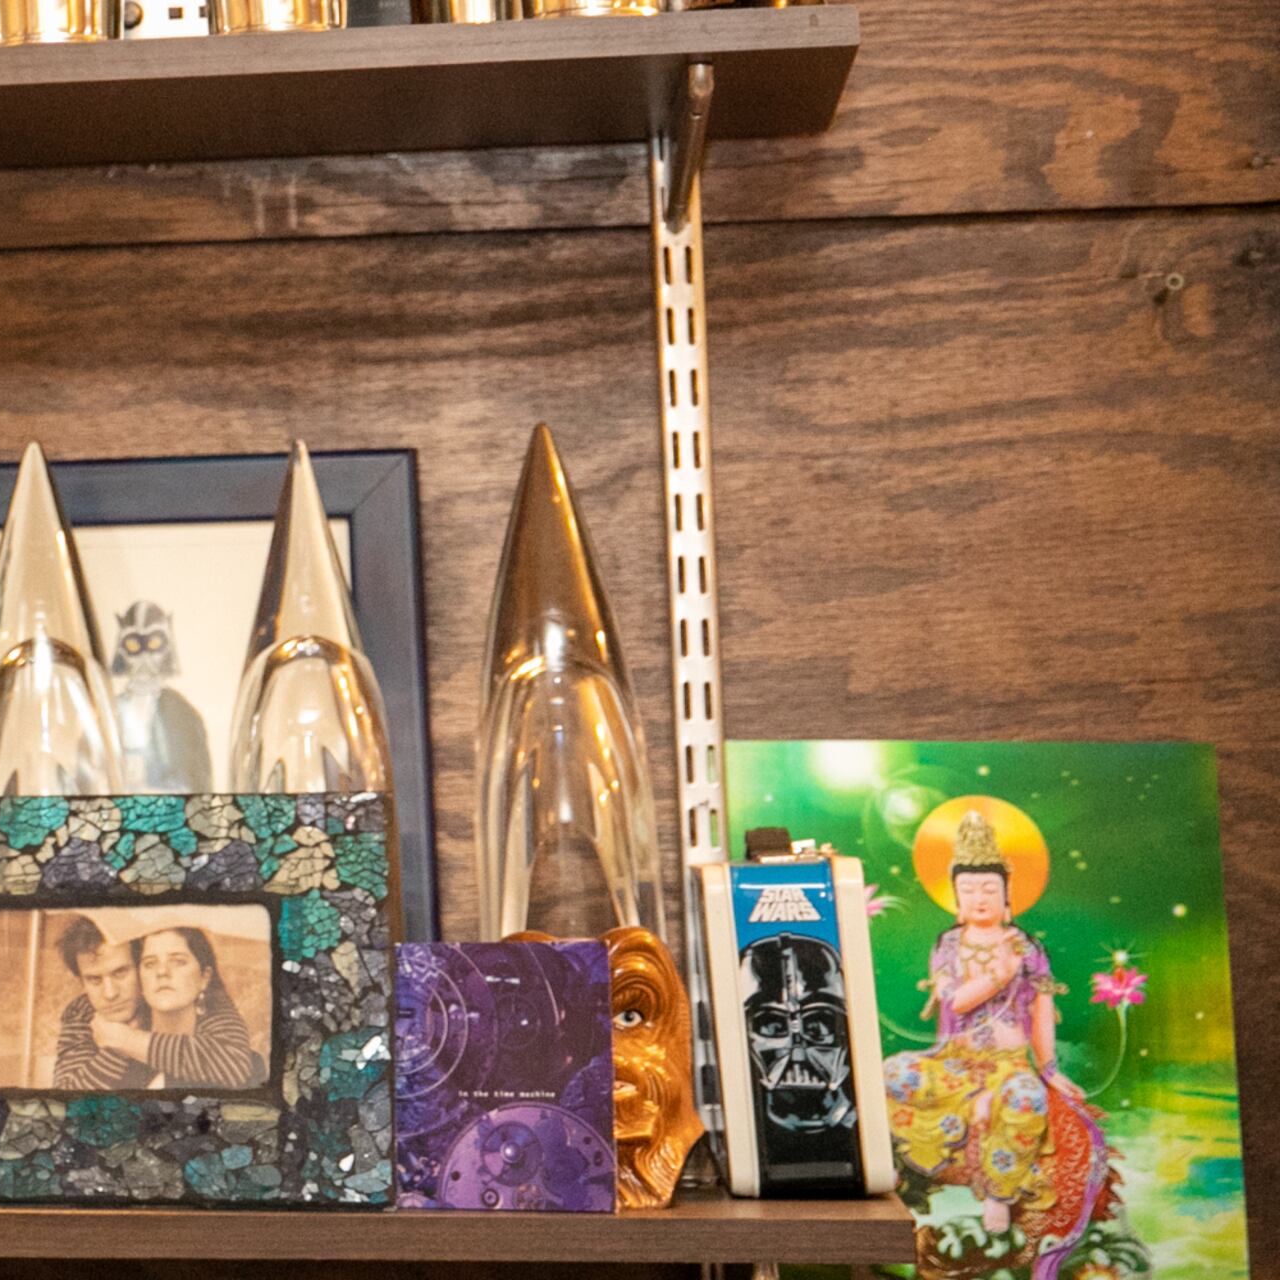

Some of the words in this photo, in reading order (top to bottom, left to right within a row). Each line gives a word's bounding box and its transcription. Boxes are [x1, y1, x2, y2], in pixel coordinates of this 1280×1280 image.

[759, 887, 809, 902] STAR
[748, 901, 822, 923] WARS
[473, 1090, 489, 1098] the
[494, 1090, 515, 1098] time
[519, 1090, 556, 1098] machine
